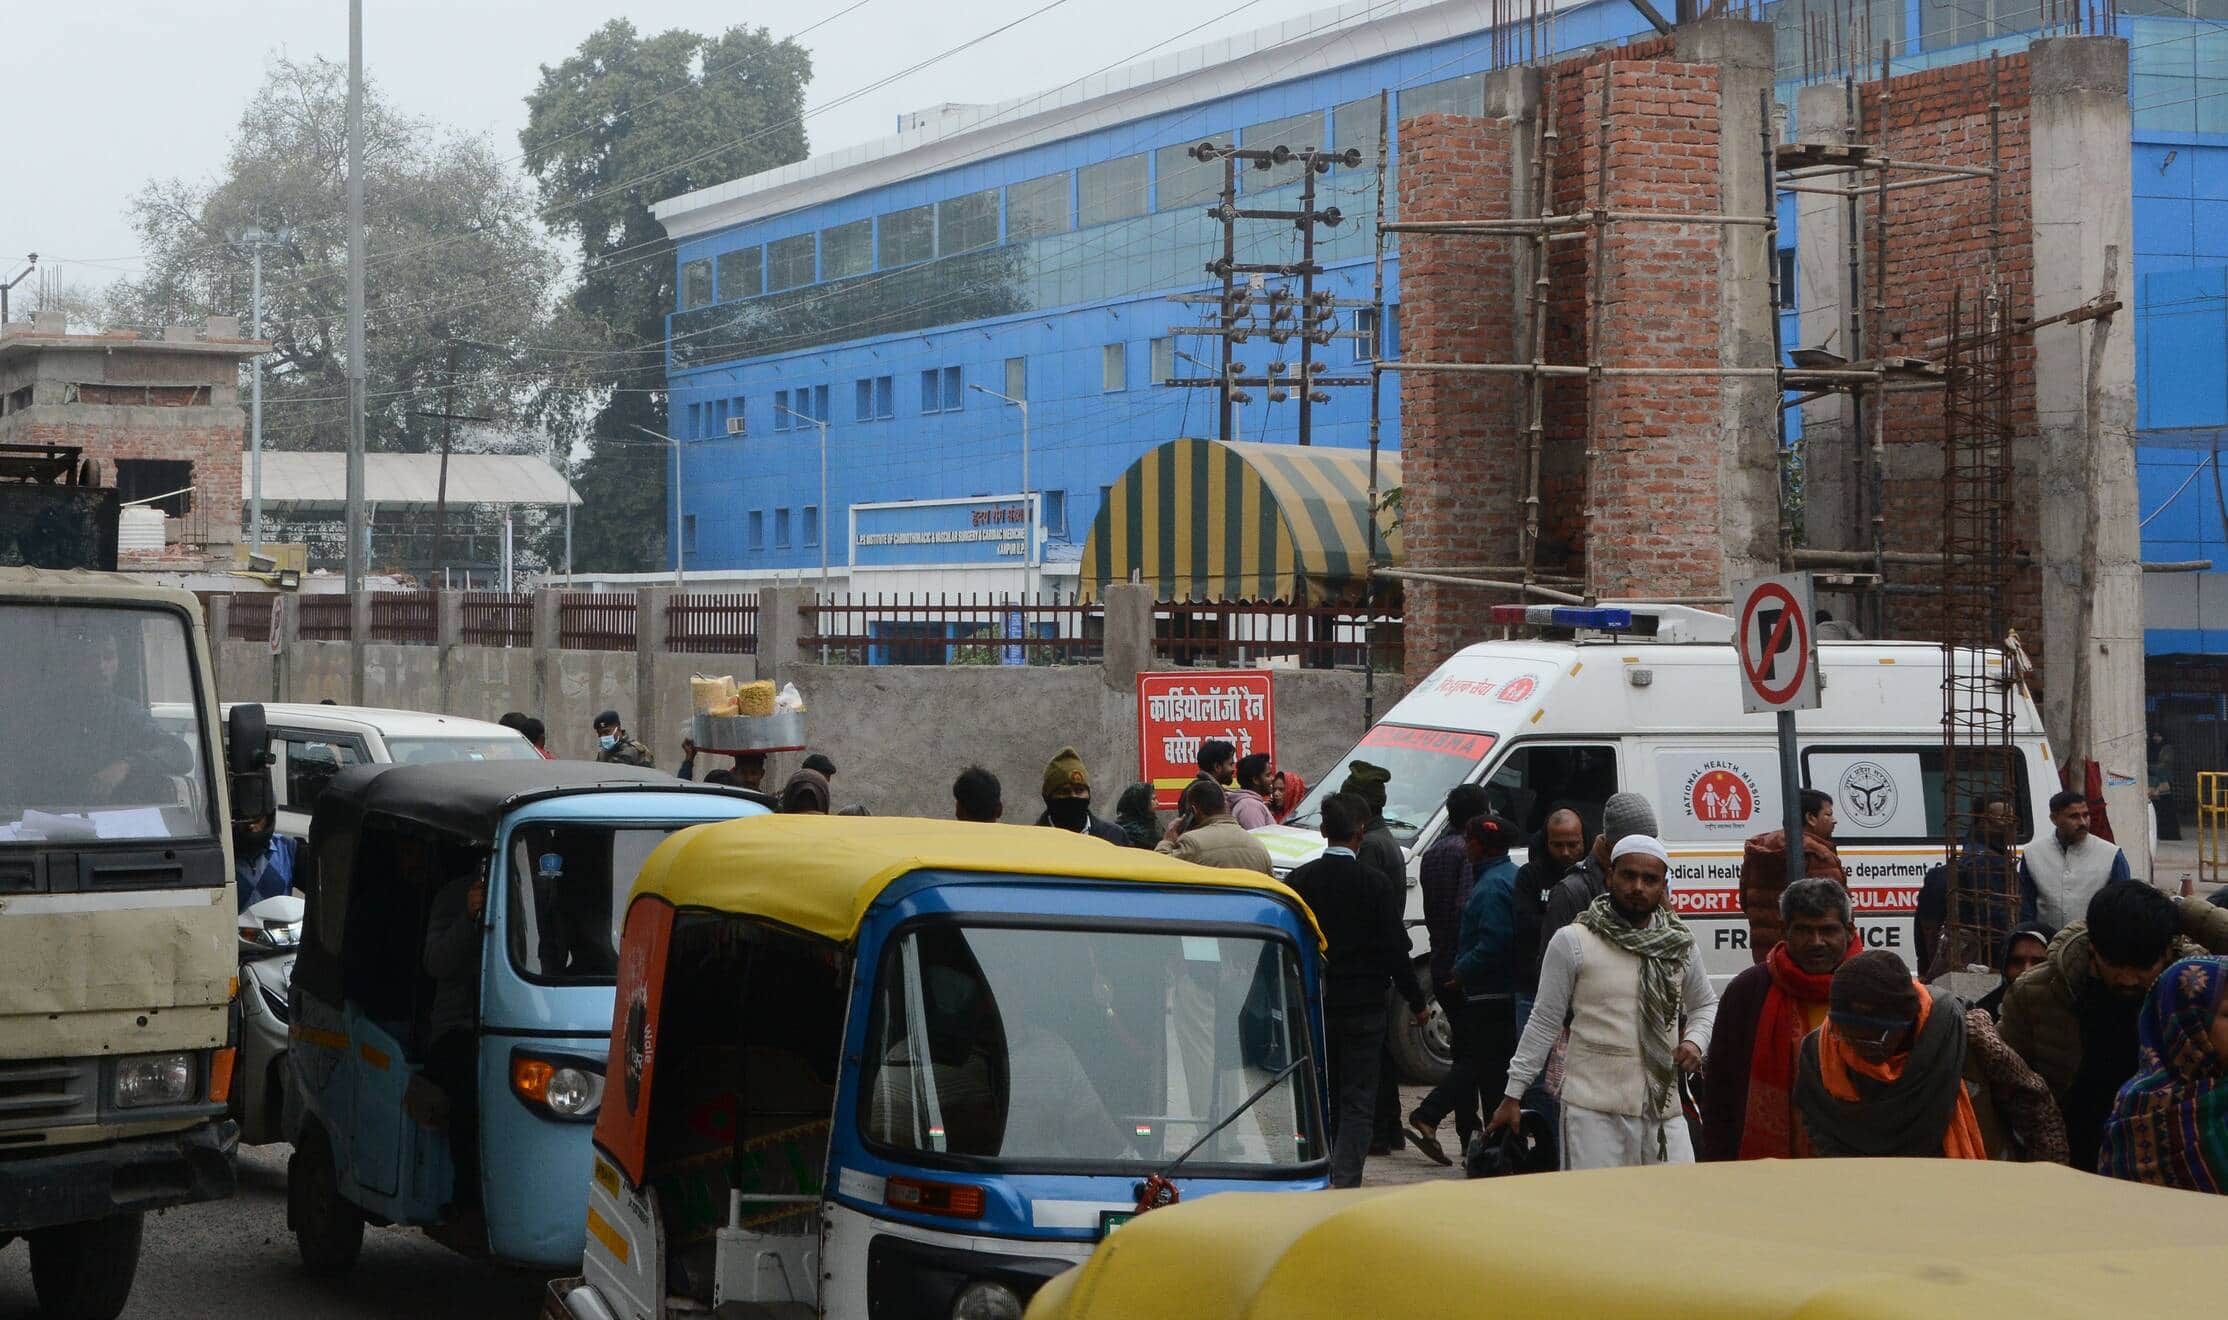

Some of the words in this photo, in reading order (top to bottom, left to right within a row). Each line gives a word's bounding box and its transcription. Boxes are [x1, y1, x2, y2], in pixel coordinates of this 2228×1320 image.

[1148, 686, 1241, 722] कार्डियोलॉजी
[1239, 686, 1264, 721] रैन
[1162, 728, 1201, 764] बसेरा
[1684, 769, 1702, 817] NATIONAL
[1703, 761, 1739, 773] HEALTH
[1741, 772, 1761, 815] MISSION
[1669, 864, 1704, 879] edical
[1708, 864, 1741, 879] Healt
[1670, 892, 1730, 910] PPORT
[1715, 928, 1748, 950] FR
